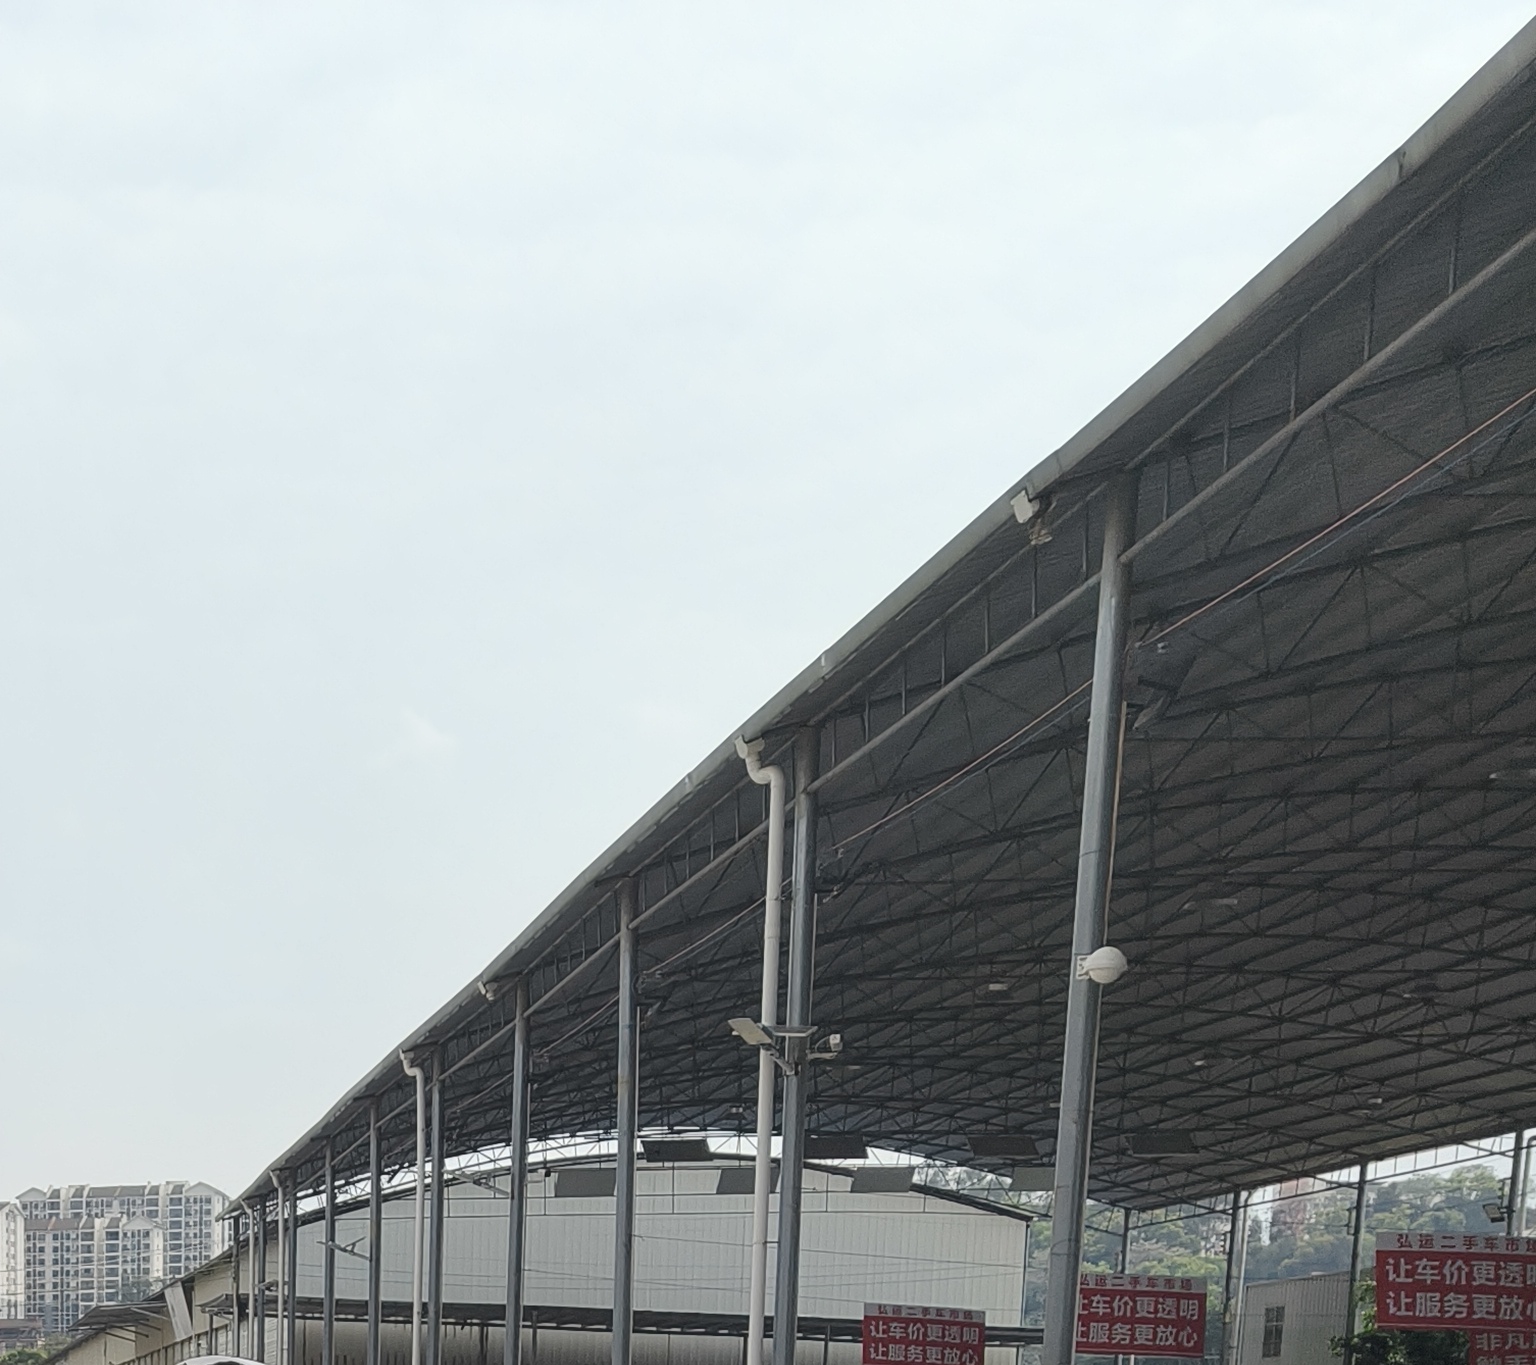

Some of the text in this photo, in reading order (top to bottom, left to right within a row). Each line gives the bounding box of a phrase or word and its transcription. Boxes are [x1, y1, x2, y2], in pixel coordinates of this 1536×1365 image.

[1397, 1233, 1536, 1251] 弘运二手车市场
[870, 1320, 979, 1344] 让车价更透明
[1475, 1333, 1536, 1350] 非凡
[869, 1342, 979, 1365] 让服务更放心
